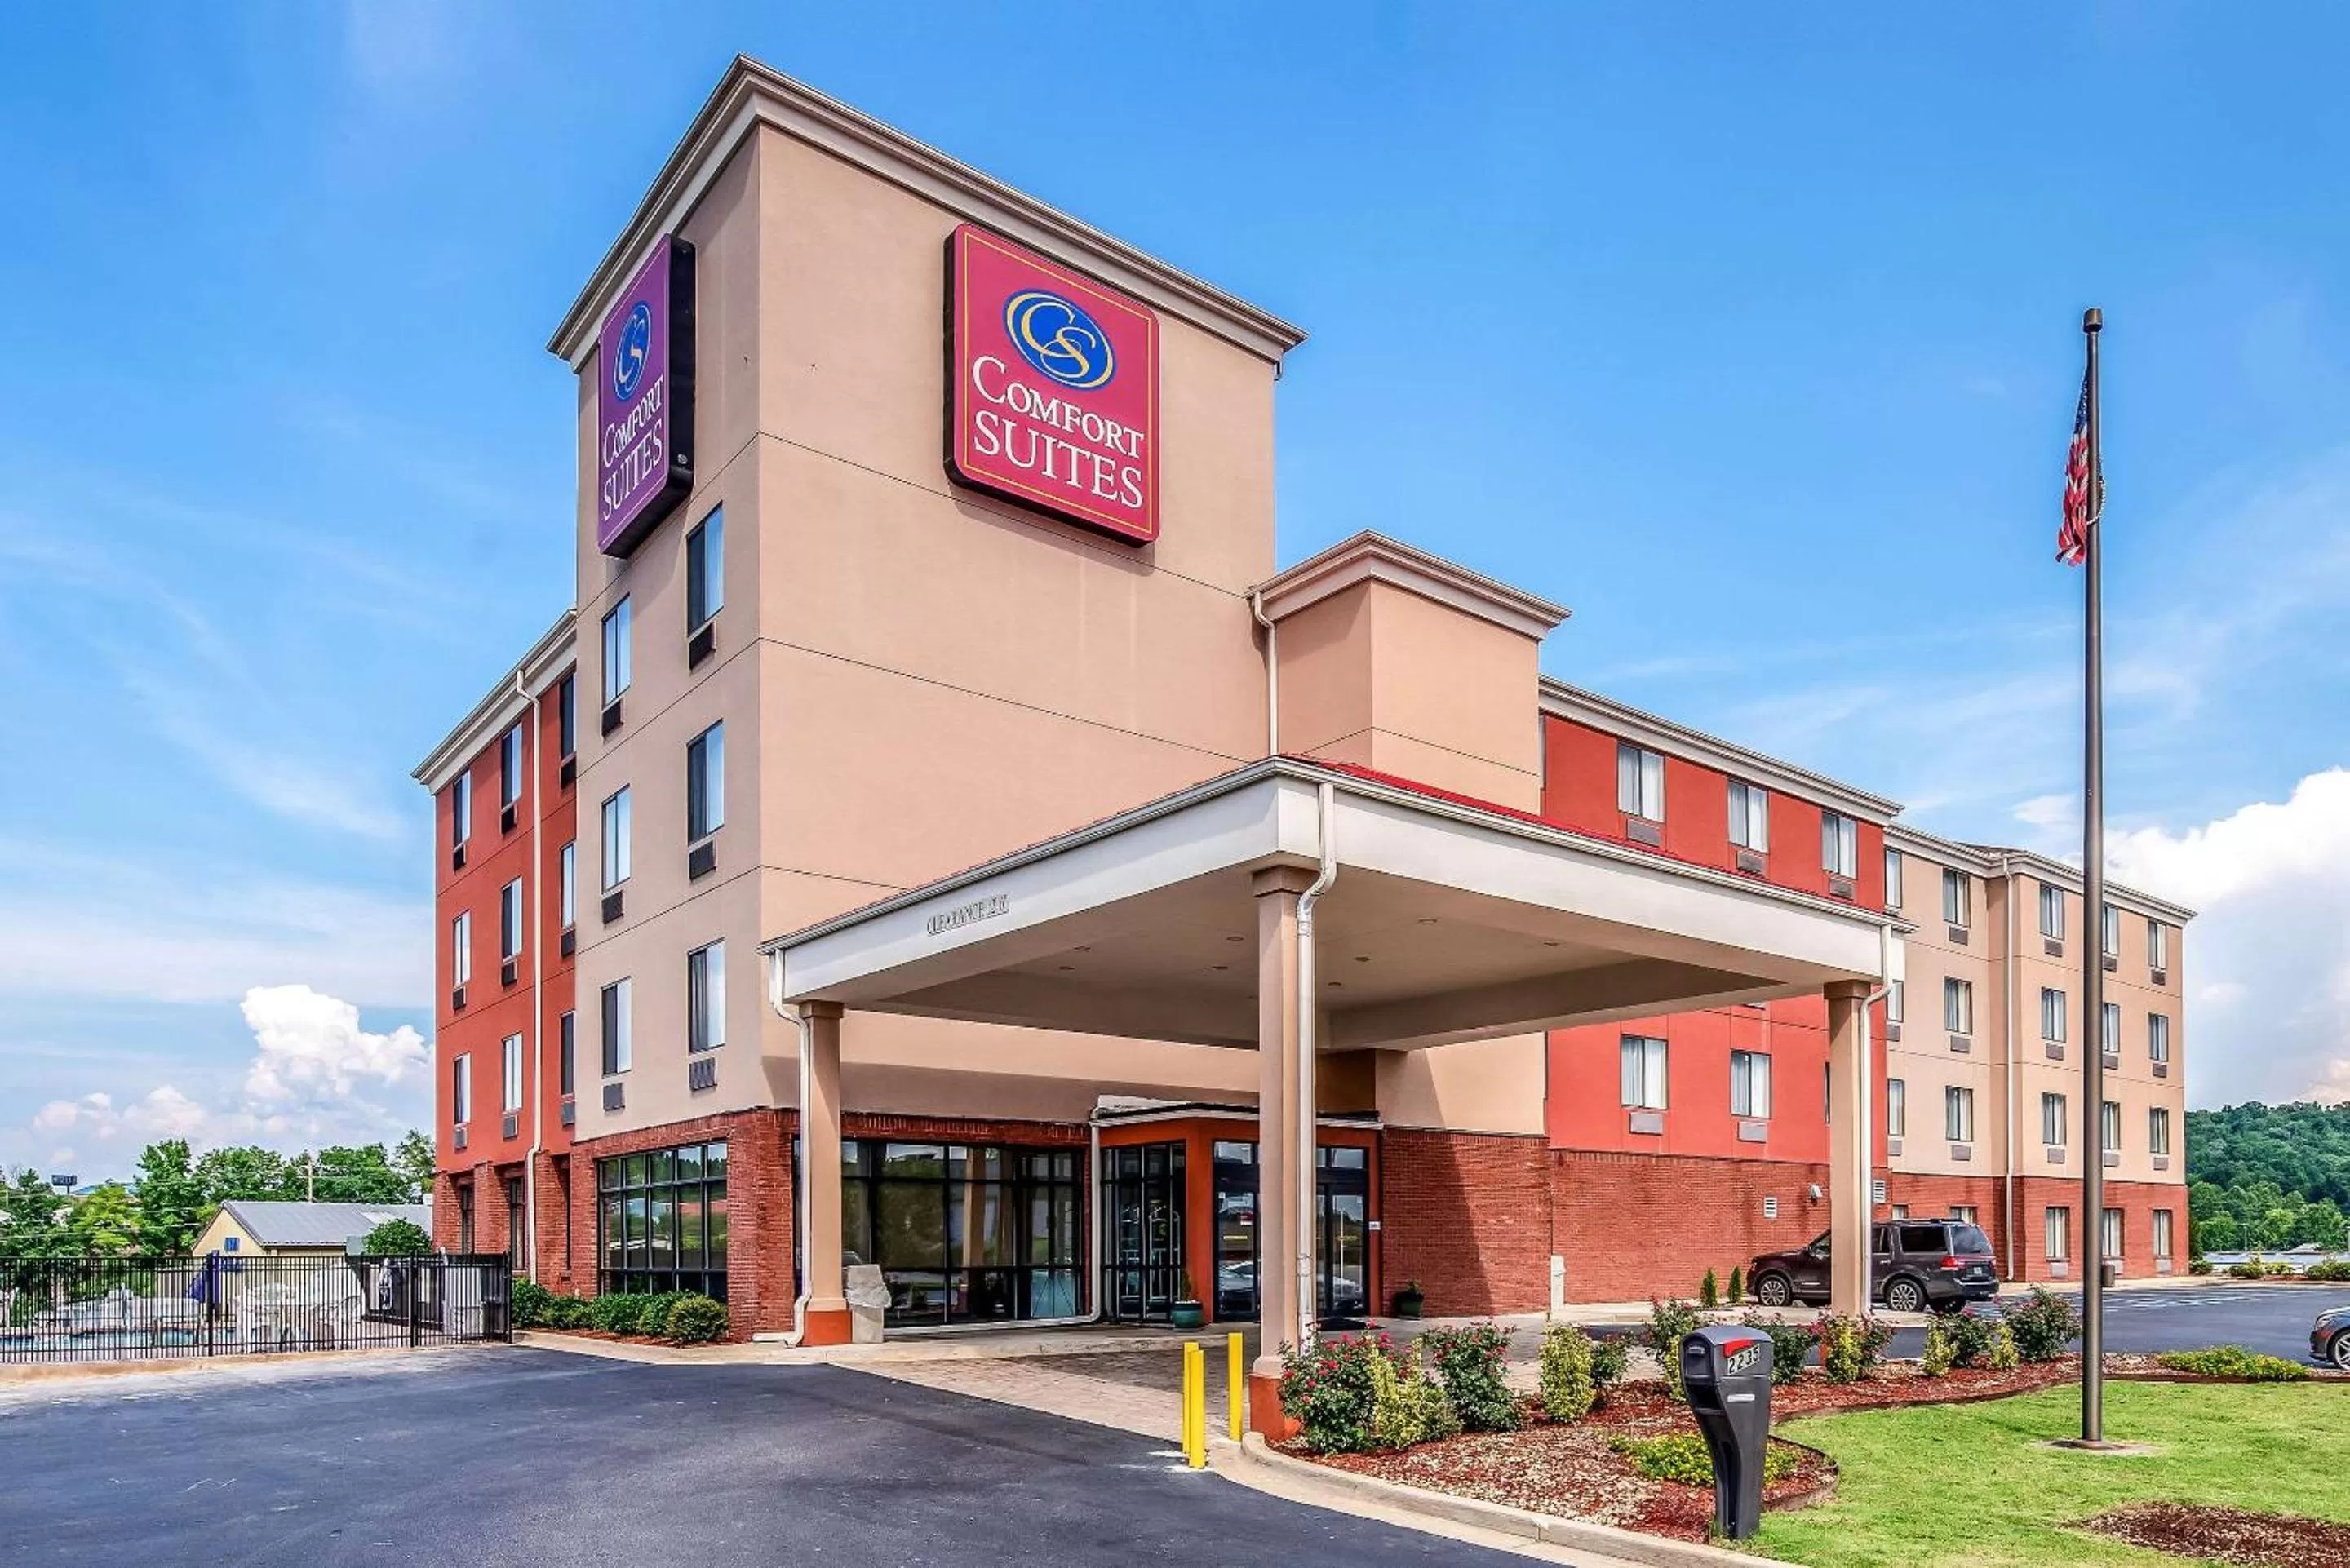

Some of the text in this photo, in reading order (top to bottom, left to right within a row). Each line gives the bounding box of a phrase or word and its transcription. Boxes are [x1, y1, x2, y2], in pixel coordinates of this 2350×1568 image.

[604, 375, 663, 467] COMFORT
[973, 355, 1144, 459] COMFORT
[602, 418, 662, 520] SUITES
[974, 410, 1142, 509] SUITES
[1729, 1346, 1759, 1374] 2235
